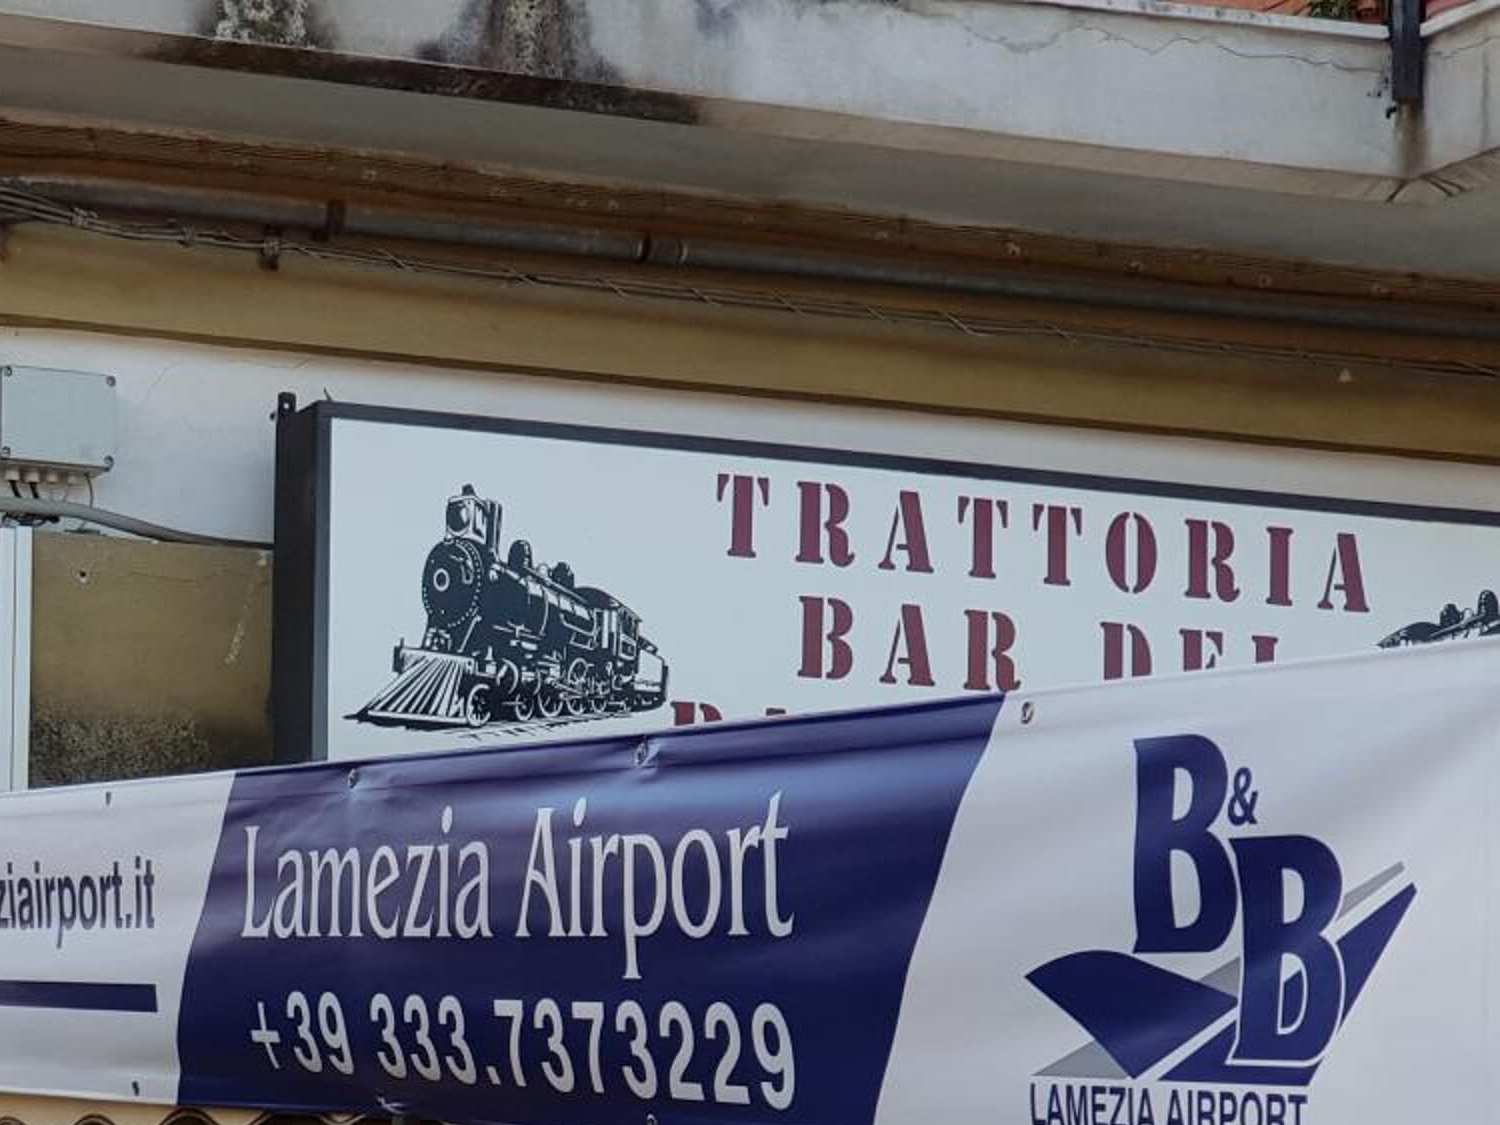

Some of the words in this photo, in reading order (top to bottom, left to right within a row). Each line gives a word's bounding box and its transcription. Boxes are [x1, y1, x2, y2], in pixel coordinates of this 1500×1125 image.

[716, 472, 1370, 612] TRATTORIA
[798, 595, 1020, 691] BAR
[241, 806, 494, 939] Lamezia
[515, 790, 795, 980] Airport
[251, 991, 354, 1076] +39
[370, 992, 796, 1110] 333.7373229
